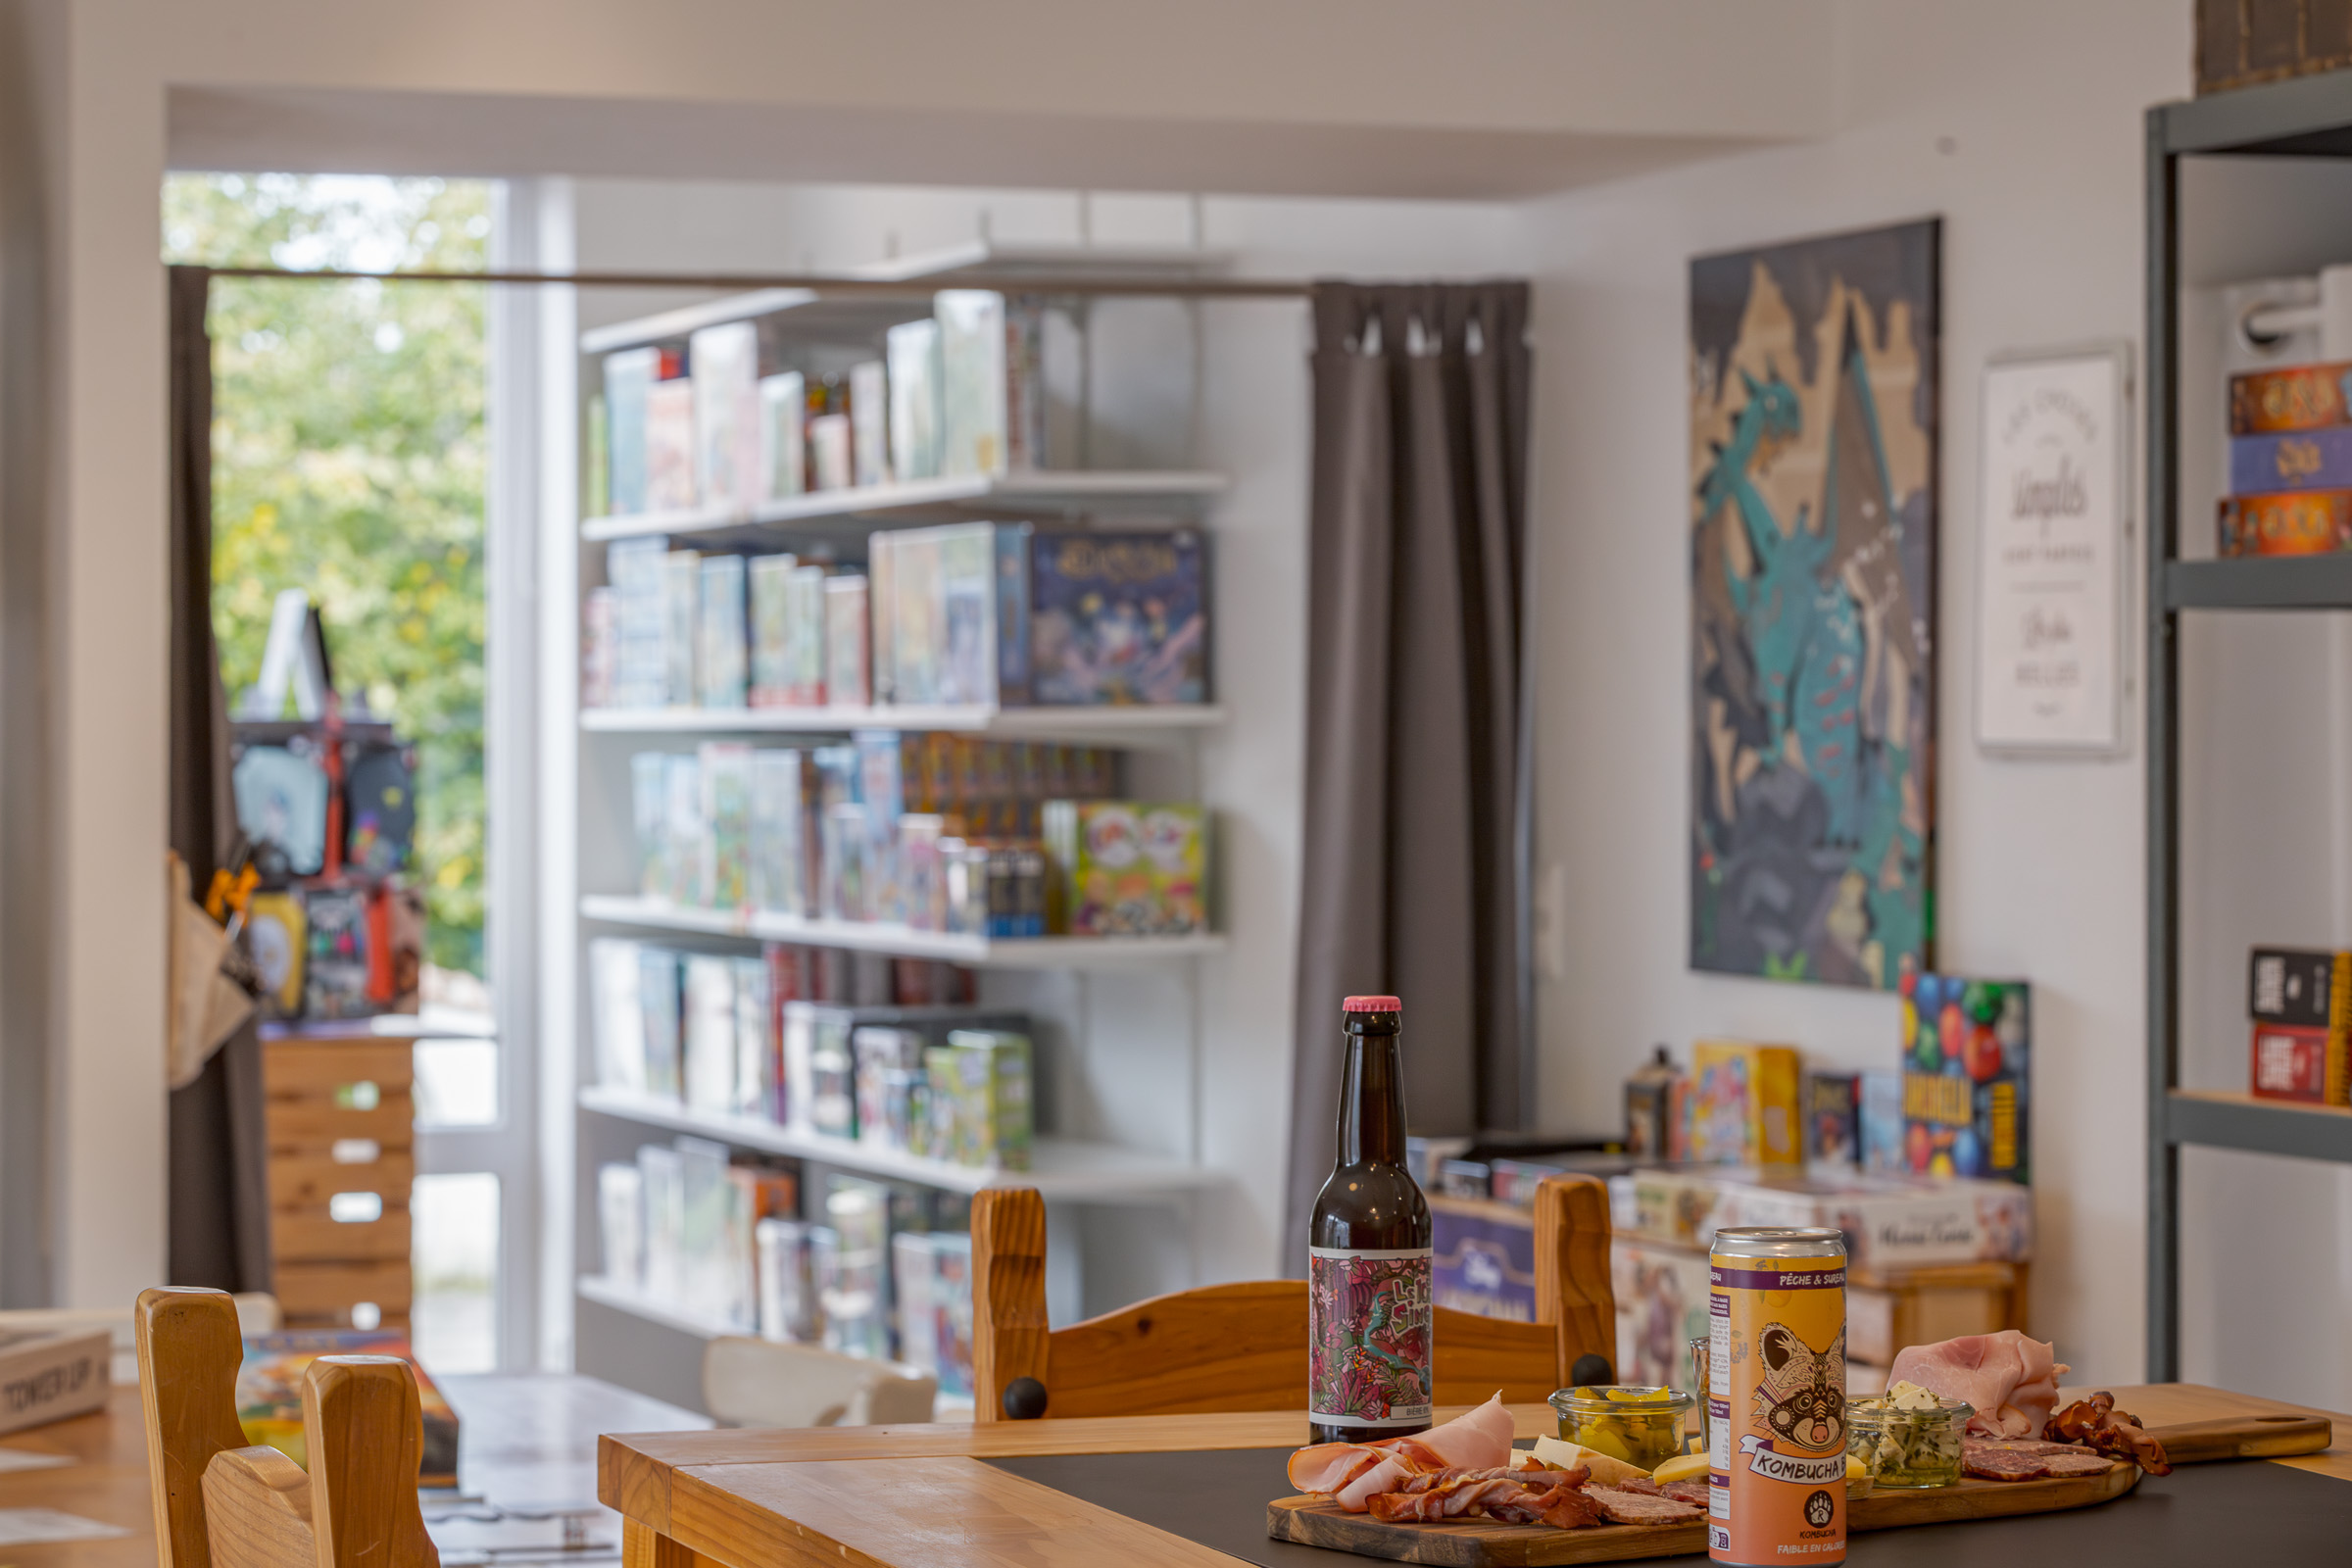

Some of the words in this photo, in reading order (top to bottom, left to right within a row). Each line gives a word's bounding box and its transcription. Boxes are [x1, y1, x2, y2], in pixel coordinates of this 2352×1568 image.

[1780, 1273, 1812, 1286] PÊCHE
[1813, 1275, 1822, 1285] &
[1823, 1273, 1844, 1284] SUREA
[3, 1365, 65, 1413] TOWER
[67, 1356, 92, 1393] UP
[1757, 1454, 1839, 1480] KOMBUCHA
[1817, 1510, 1825, 1521] R
[1799, 1529, 1836, 1539] KOMBUCHA
[1777, 1544, 1808, 1554] FAIBLE
[1810, 1544, 1821, 1552] EN
